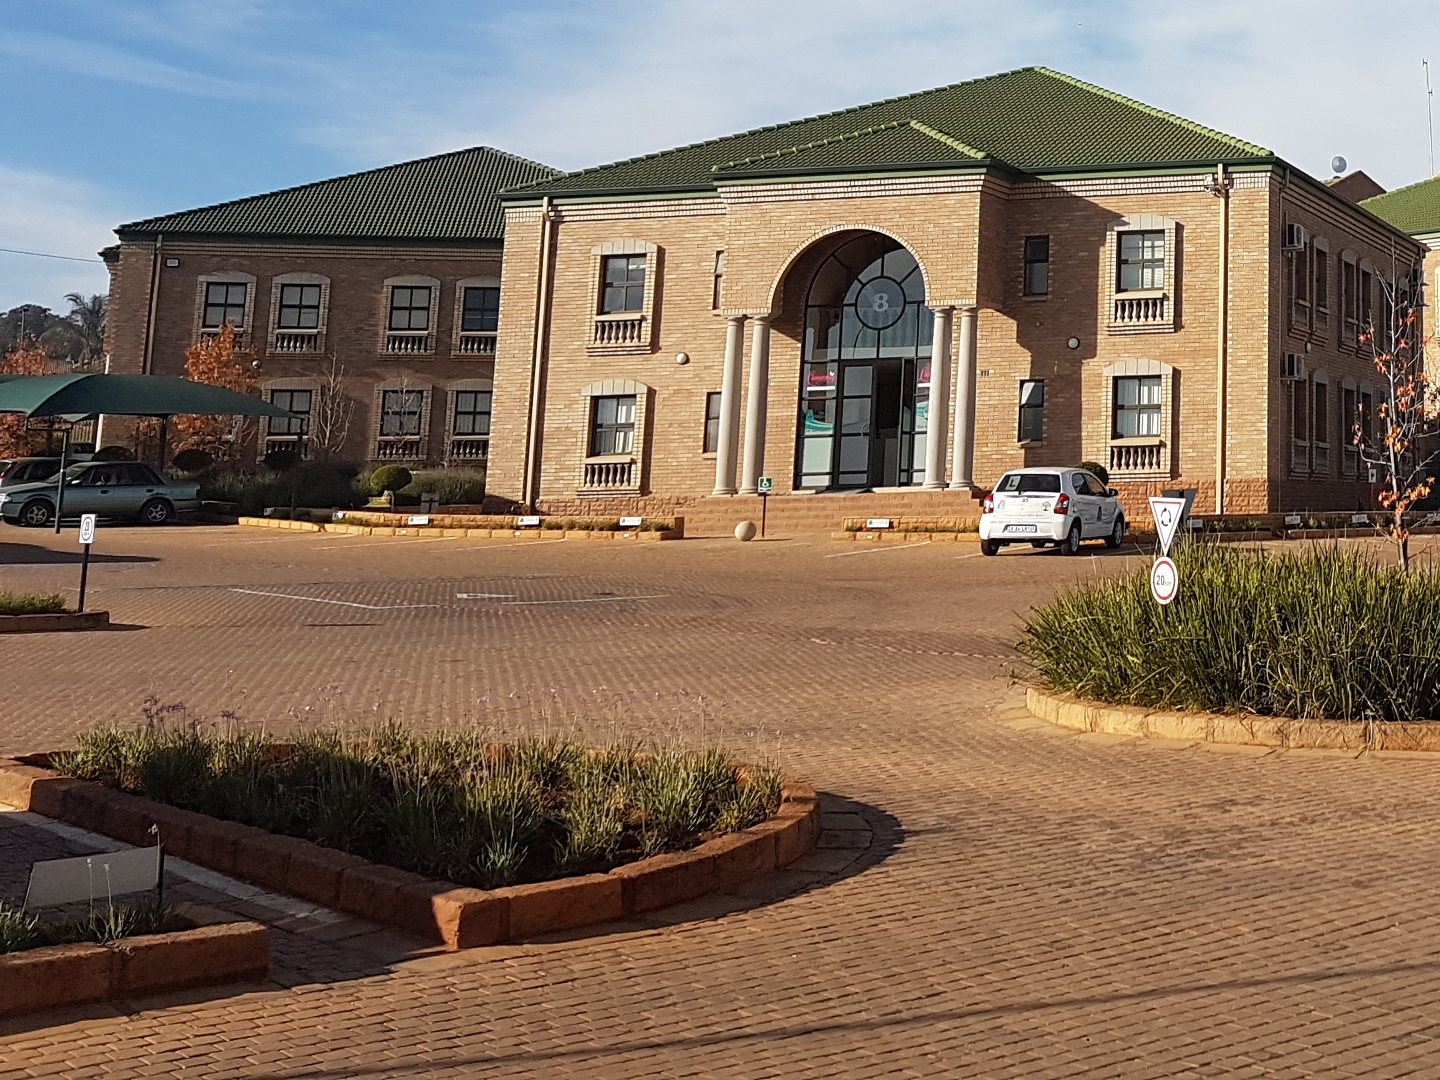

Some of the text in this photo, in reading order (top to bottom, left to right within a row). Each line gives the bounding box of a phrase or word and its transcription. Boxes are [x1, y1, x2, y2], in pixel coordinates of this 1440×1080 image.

[873, 293, 889, 312] 8
[1009, 478, 1016, 487] L
[1156, 575, 1165, 585] 20
